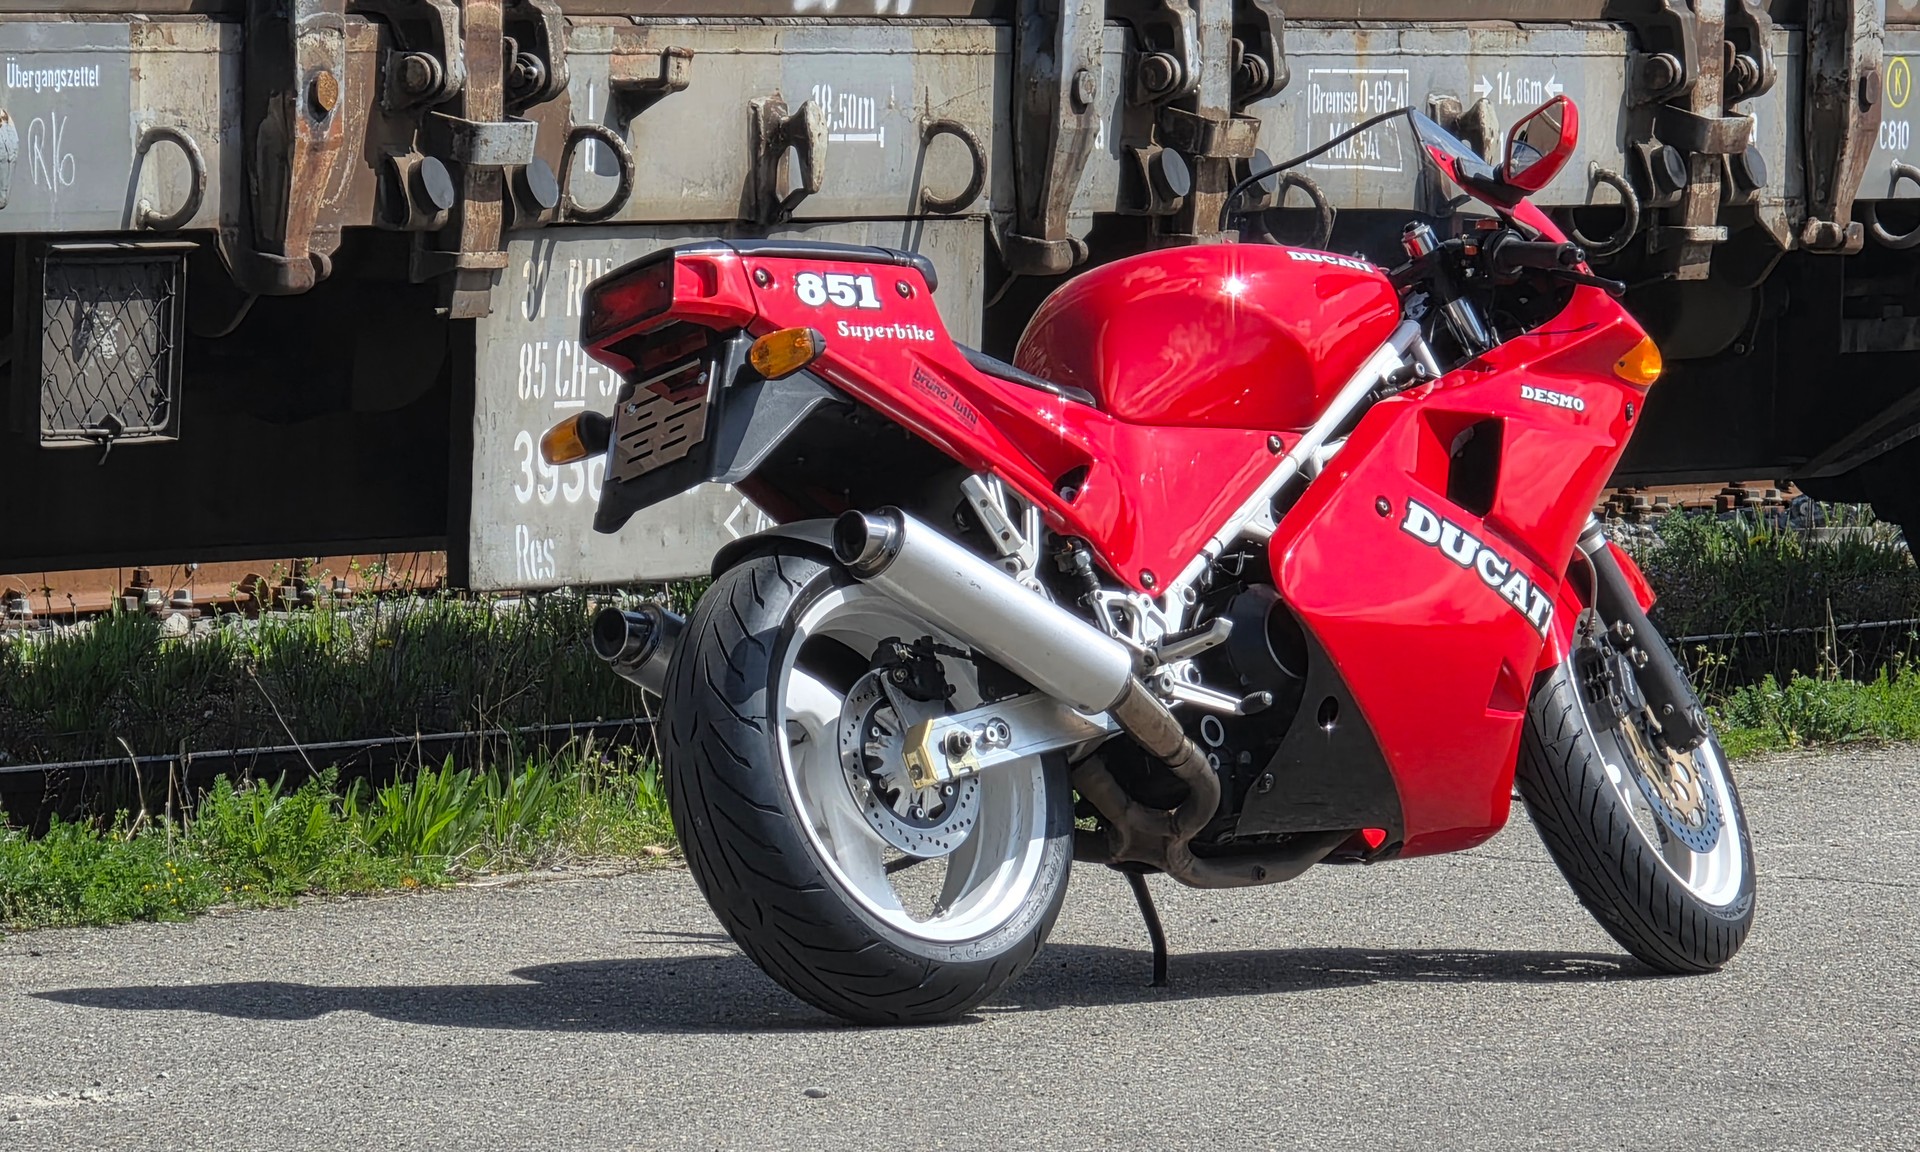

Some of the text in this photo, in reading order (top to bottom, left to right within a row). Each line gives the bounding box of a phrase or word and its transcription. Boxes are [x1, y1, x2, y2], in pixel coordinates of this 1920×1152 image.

[6, 57, 99, 93] Übergangszettel
[1312, 83, 1358, 114] Bremse
[1879, 120, 1910, 150] C810
[1286, 250, 1374, 273] DUCATI
[796, 271, 881, 309] 851
[837, 320, 935, 341] Superbike
[518, 341, 548, 400] 85
[912, 366, 948, 400] bruno
[1521, 384, 1585, 411] DESMO
[515, 524, 556, 581] Res
